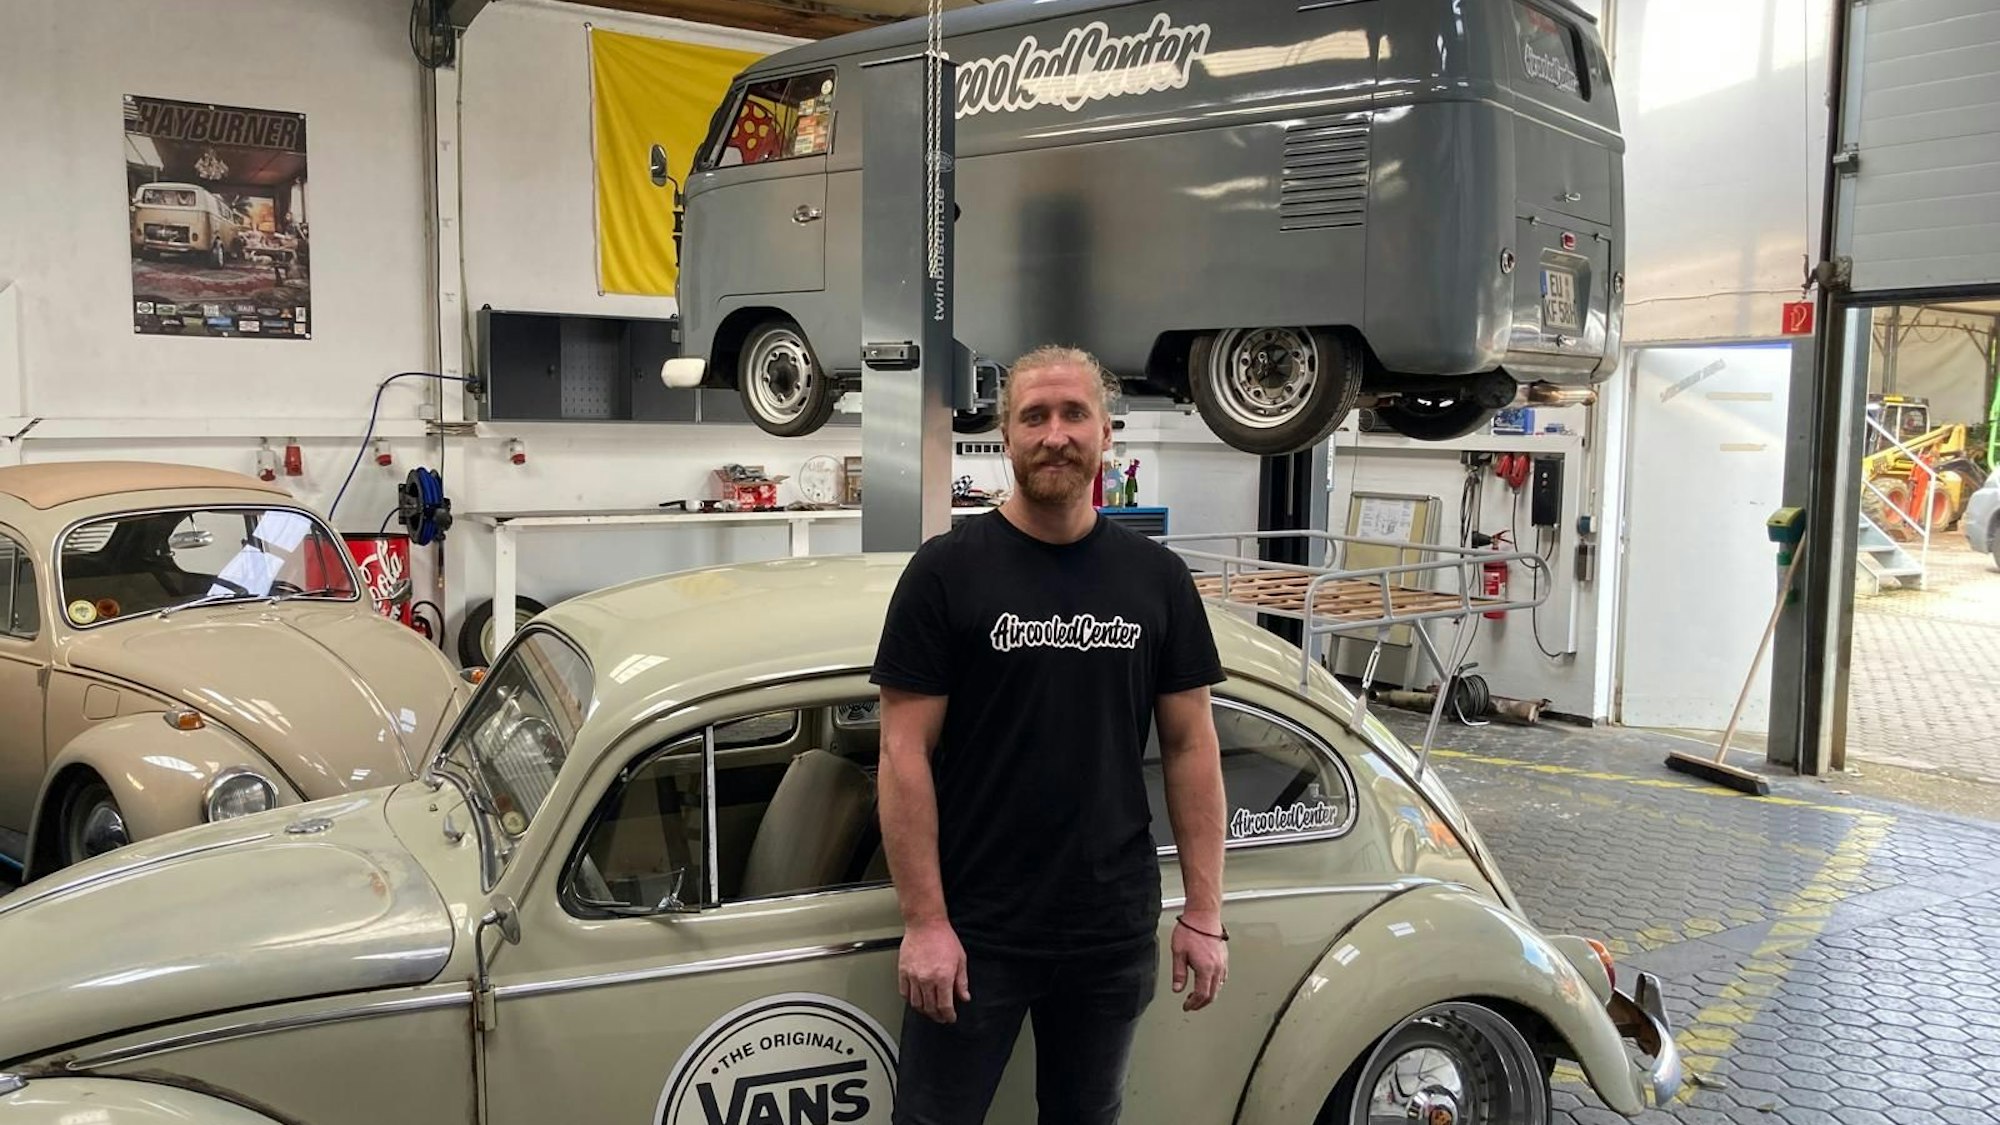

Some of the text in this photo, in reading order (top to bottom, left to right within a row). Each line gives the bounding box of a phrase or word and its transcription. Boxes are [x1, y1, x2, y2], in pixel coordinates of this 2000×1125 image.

[955, 12, 1212, 120] cooledCenter
[137, 102, 299, 149] HAYBURNER
[990, 612, 1142, 651] AircooledCenter
[1231, 801, 1338, 838] AircooledCenter
[718, 1032, 843, 1068] THE ORIGINAL
[696, 1059, 870, 1125] VANS
